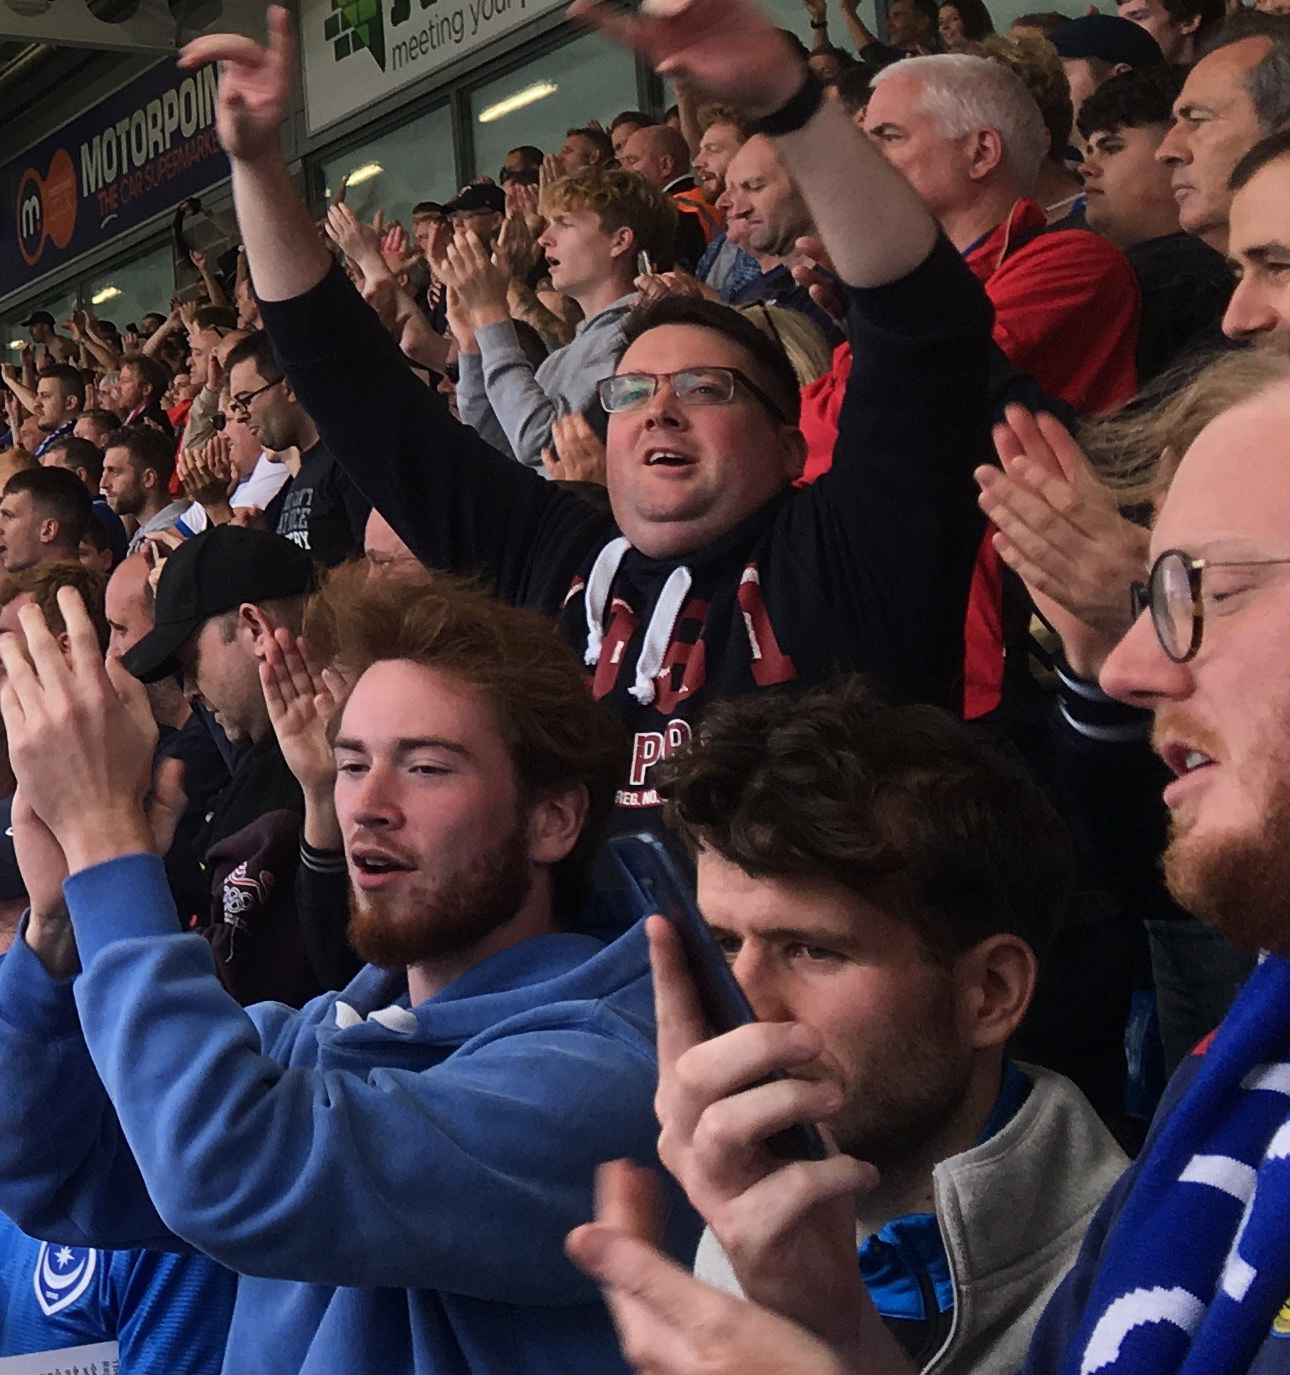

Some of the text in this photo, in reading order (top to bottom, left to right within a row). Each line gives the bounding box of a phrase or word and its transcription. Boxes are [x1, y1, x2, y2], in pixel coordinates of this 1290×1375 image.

[391, 13, 466, 70] meeting
[81, 61, 222, 198] MOTORPOIN
[97, 187, 118, 217] THE
[145, 128, 220, 192] SUPERMARKE
